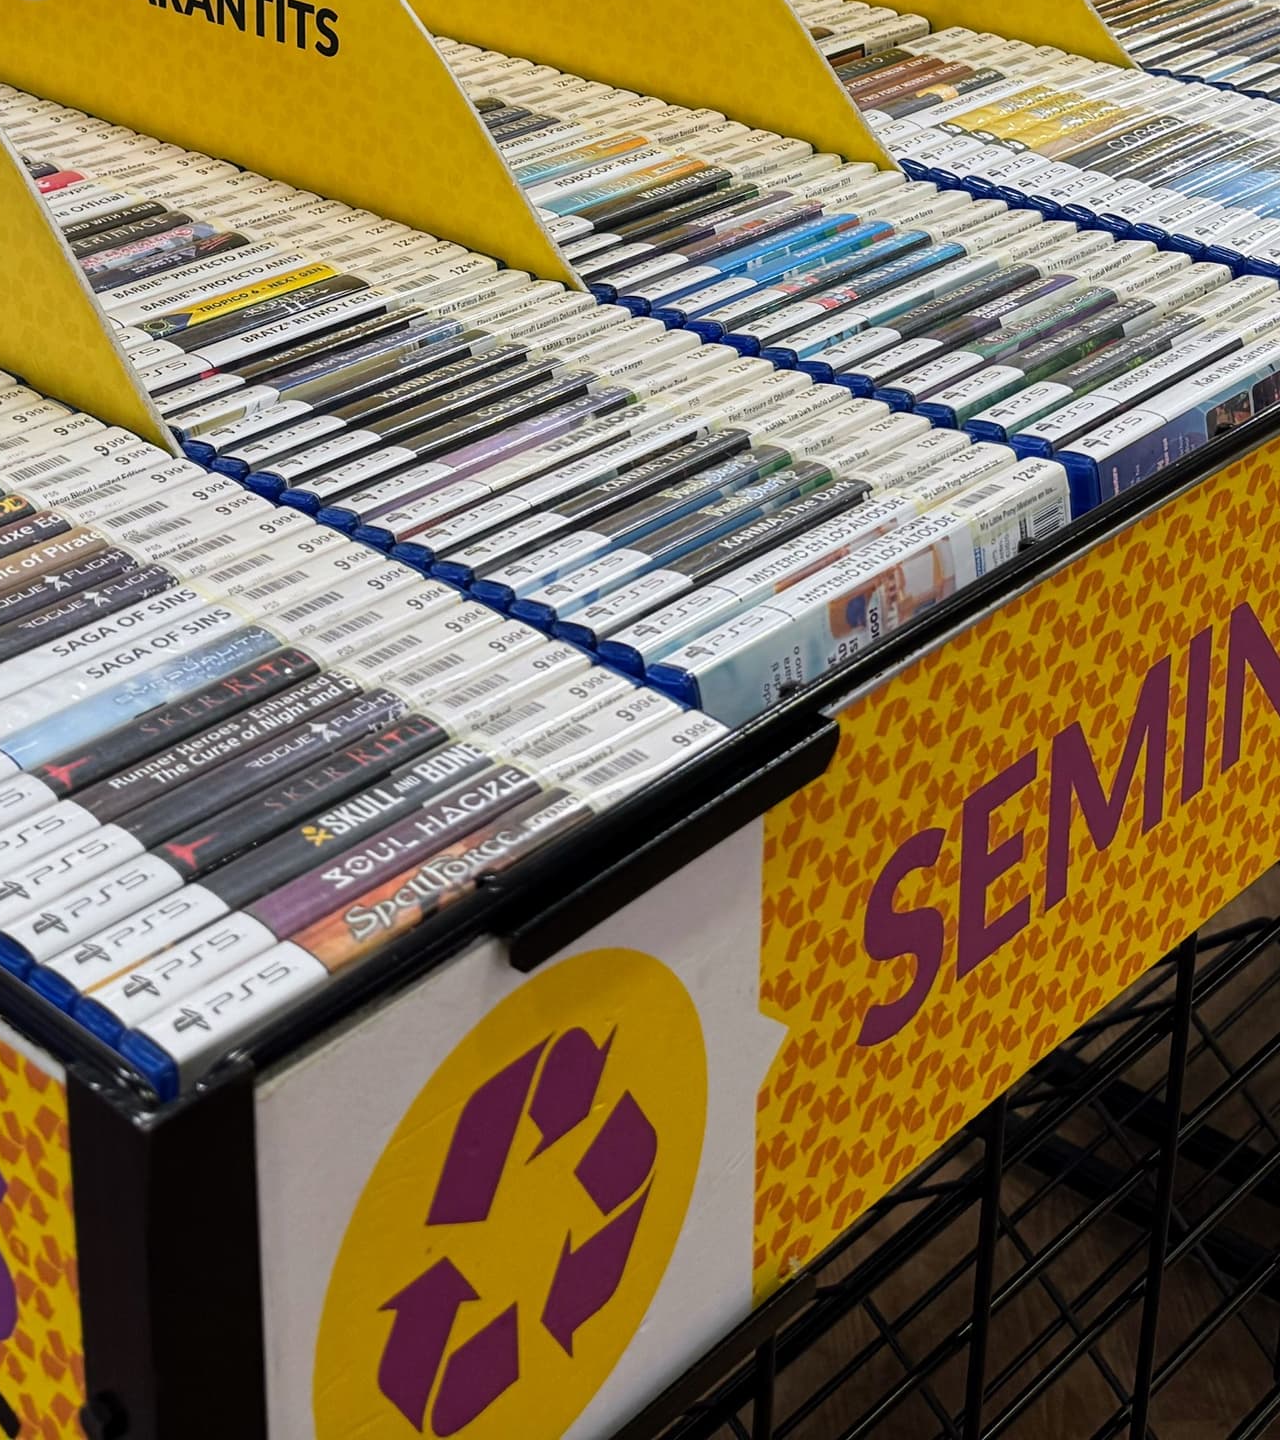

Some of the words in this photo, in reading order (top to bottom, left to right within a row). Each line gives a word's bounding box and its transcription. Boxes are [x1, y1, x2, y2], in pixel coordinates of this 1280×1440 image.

[21, 552, 43, 570] of
[44, 528, 104, 560] Pirate
[719, 513, 783, 550] KARMA:
[786, 496, 810, 520] The
[813, 478, 853, 504] Dark
[18, 598, 87, 630] ROGUE
[103, 566, 166, 597] FLIGHT
[745, 549, 809, 586] MISTERIO
[86, 647, 149, 680] SAGA
[150, 631, 180, 650] OF
[187, 609, 232, 635] SINS
[109, 754, 174, 789] Runner
[178, 722, 239, 756] Heroes
[250, 678, 330, 721] Enhanced
[151, 763, 188, 786] The
[189, 739, 239, 770] Curse
[240, 730, 262, 747] of
[262, 703, 308, 738] Night
[310, 690, 340, 712] and
[323, 832, 418, 891] SOUL
[422, 768, 530, 837] HACKE
[210, 962, 295, 1018] PS5
